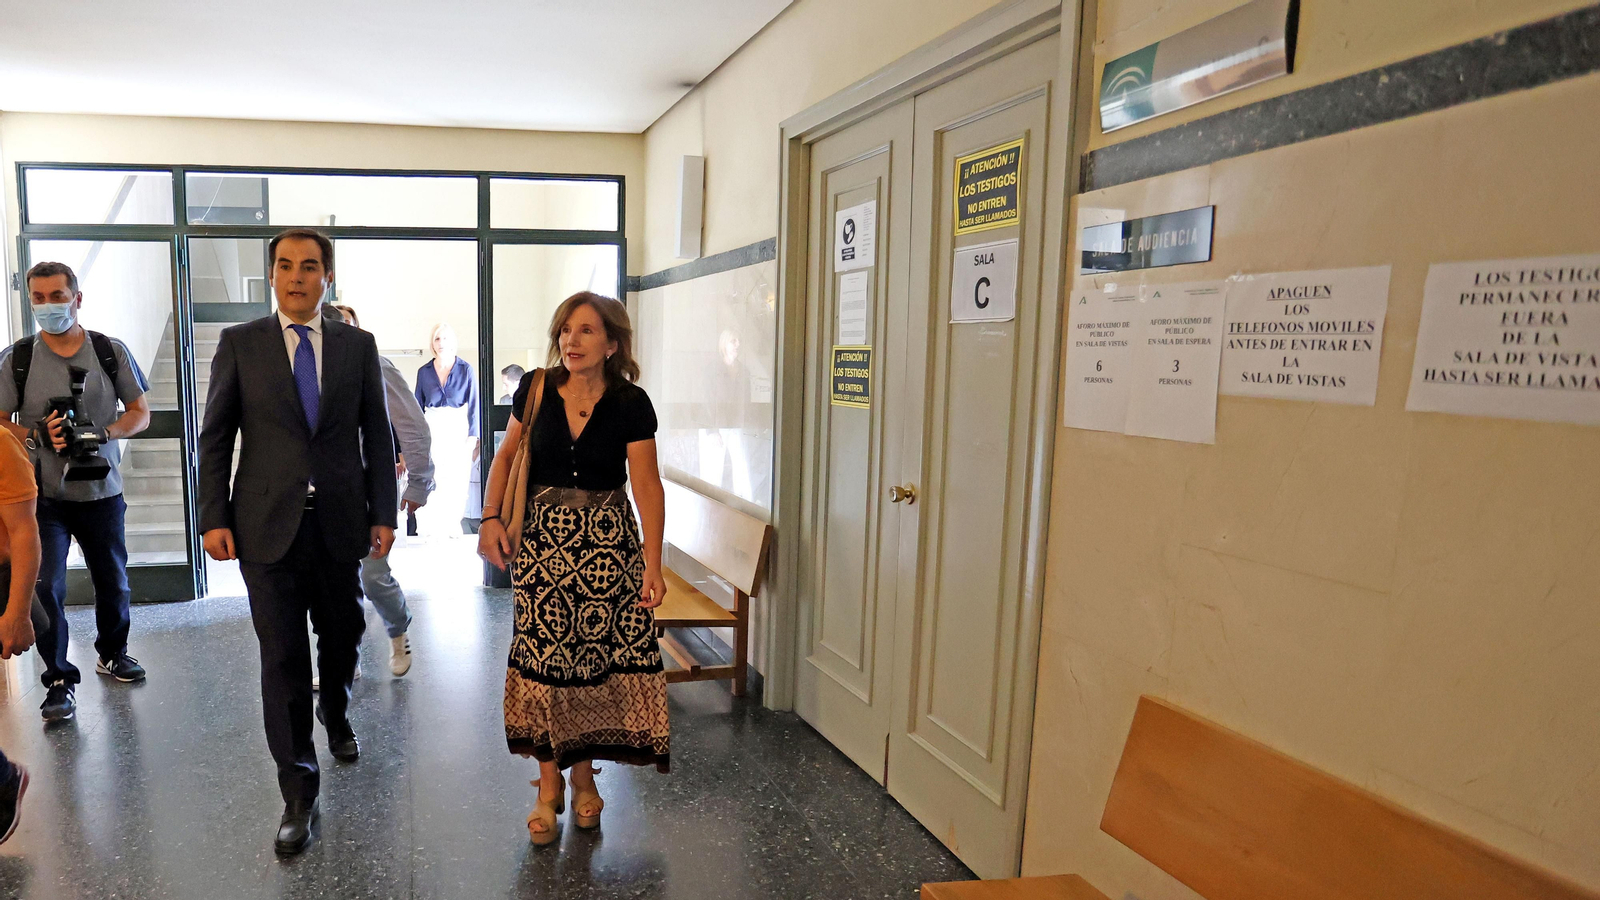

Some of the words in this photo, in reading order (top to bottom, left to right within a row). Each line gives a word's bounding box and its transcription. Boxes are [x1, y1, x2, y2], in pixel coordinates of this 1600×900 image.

[970, 153, 1008, 175] ATENCIÓN
[959, 183, 976, 197] LOS
[977, 172, 1016, 193] TESTIGOS
[967, 202, 978, 214] NO
[978, 195, 1007, 212] ENTREN
[959, 217, 974, 227] HASTA
[975, 214, 985, 224] SER
[986, 208, 1016, 222] LLAMADOS
[1121, 237, 1134, 254] DE
[1137, 227, 1197, 252] AUDIENCIA
[973, 252, 995, 266] SALA
[1474, 272, 1511, 286] LOS
[974, 276, 991, 309] C
[1267, 285, 1332, 300] APAGUEN
[1284, 304, 1310, 316] LOS
[1501, 312, 1568, 326] FUERA
[1227, 322, 1304, 334] TELEFONOS
[1307, 320, 1375, 334] MOVILES
[1226, 338, 1267, 350] ANTES
[1270, 339, 1287, 350] DE
[1290, 339, 1348, 351] ENTRAR
[1352, 339, 1373, 351] EN
[1502, 331, 1527, 345] DE
[1533, 332, 1560, 346] LA
[841, 351, 863, 361] ATENCIÓN
[1282, 356, 1300, 368] LA
[1453, 351, 1499, 365] SALA
[1505, 352, 1530, 365] DE
[1096, 359, 1102, 372] 6
[1172, 359, 1180, 373] 3
[834, 368, 843, 376] LOS
[845, 368, 868, 378] TESTIGOS
[1083, 376, 1113, 384] PERSONAS
[1241, 371, 1273, 384] SALA
[1276, 373, 1294, 385] DE
[1297, 374, 1346, 388] VISTAS
[1423, 368, 1480, 384] HASTA
[1485, 371, 1520, 387] SER
[838, 383, 844, 391] NO
[845, 384, 863, 392] ENTREN
[1158, 378, 1192, 386] PERSONAS
